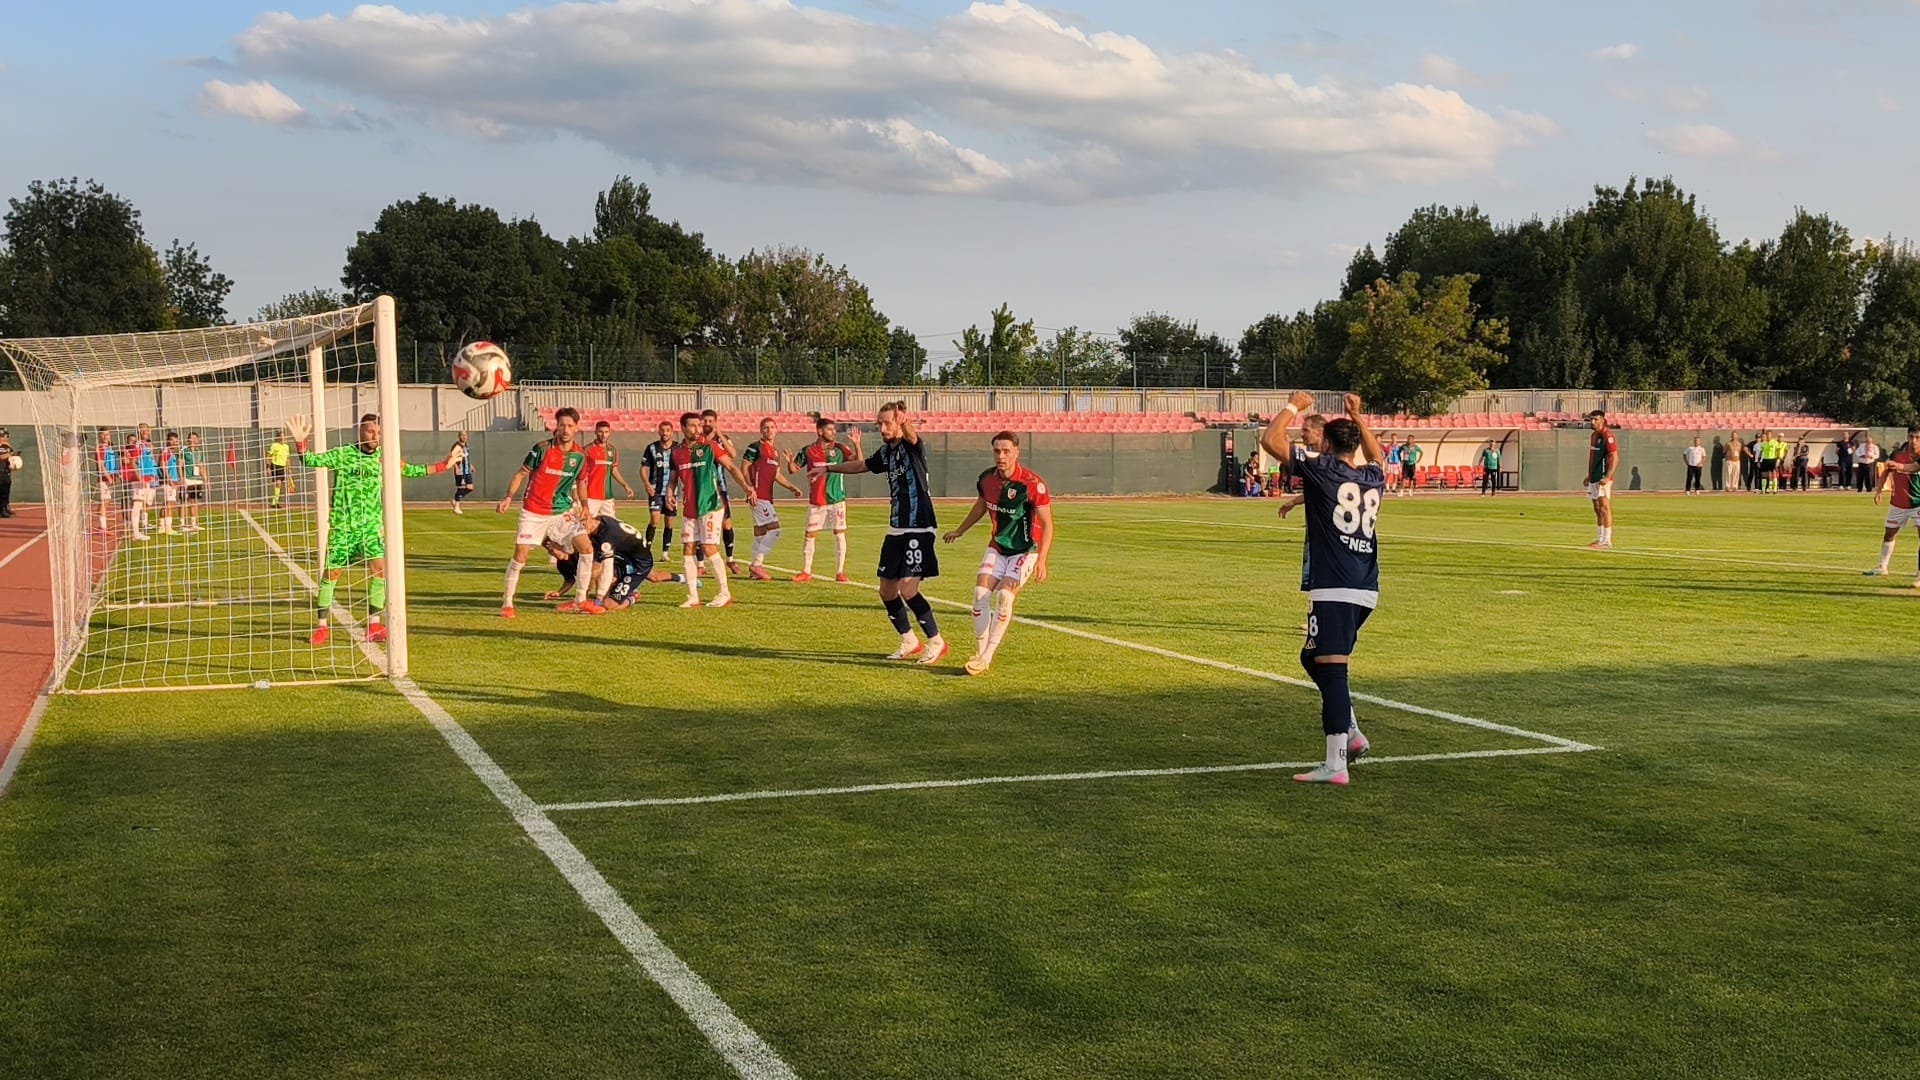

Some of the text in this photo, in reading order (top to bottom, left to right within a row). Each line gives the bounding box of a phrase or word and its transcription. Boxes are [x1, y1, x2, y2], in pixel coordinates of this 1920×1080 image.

[1332, 482, 1380, 538] 88
[707, 521, 713, 533] 9
[906, 549, 922, 565] 39
[615, 582, 630, 596] 93
